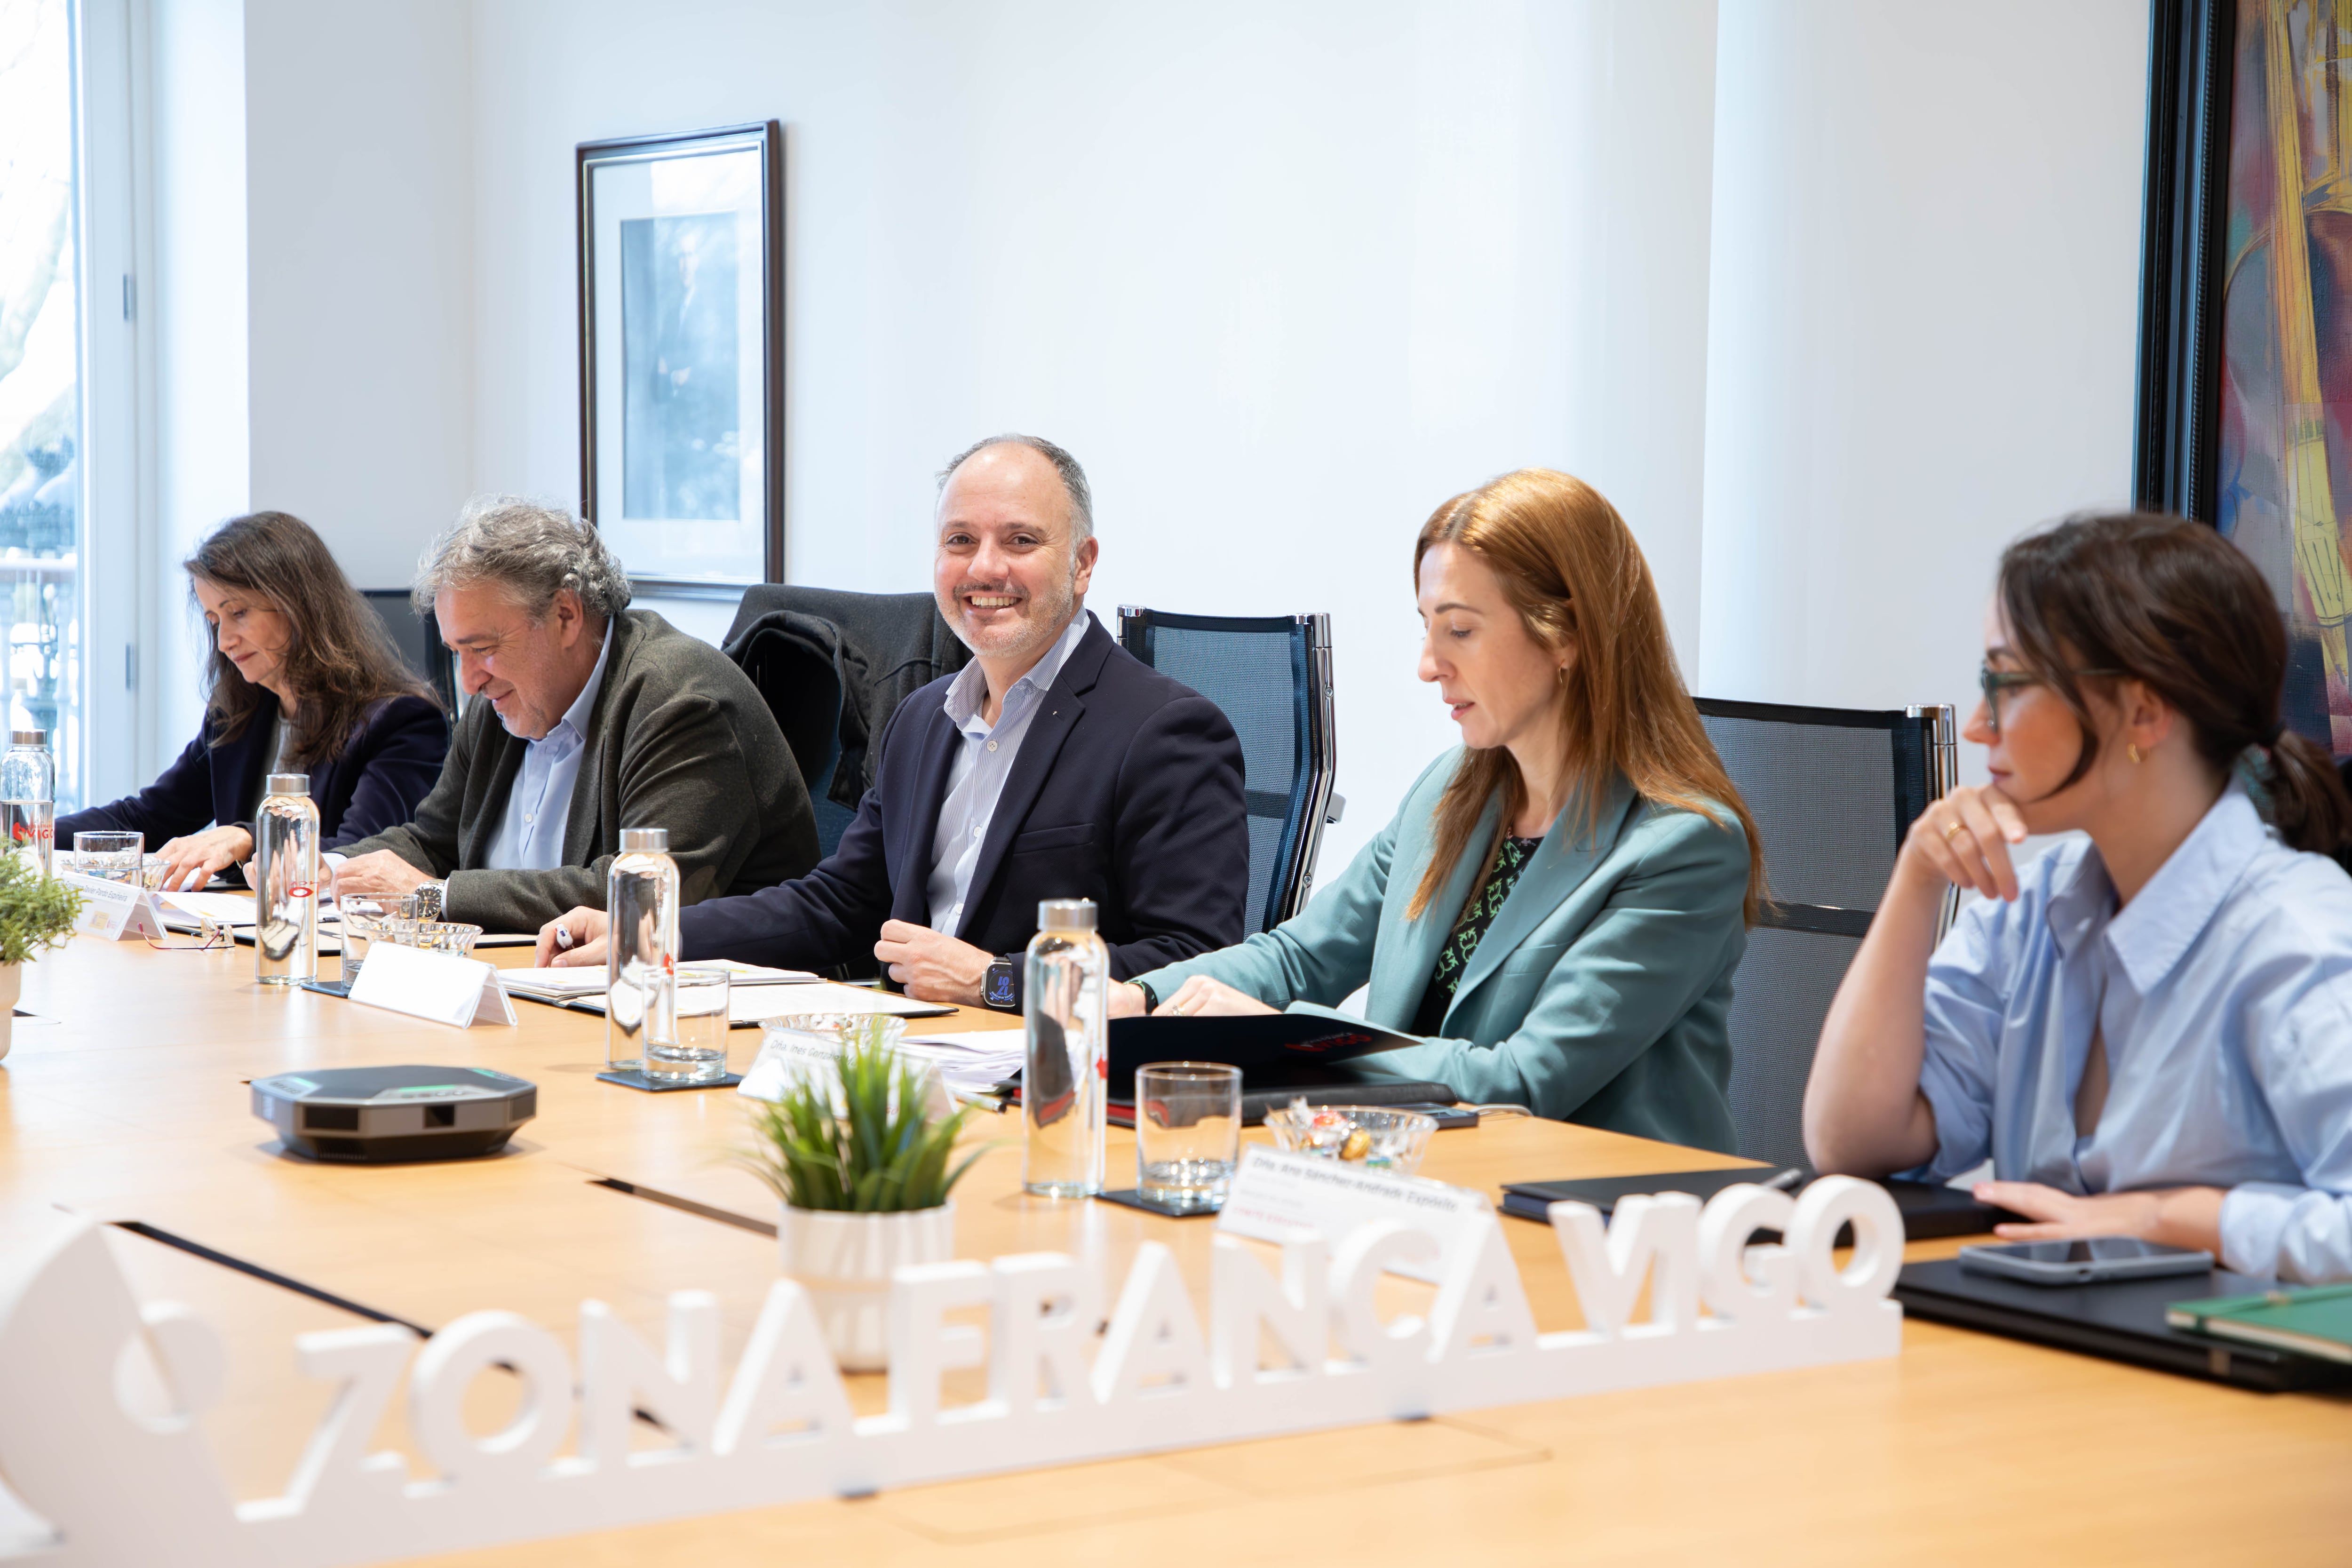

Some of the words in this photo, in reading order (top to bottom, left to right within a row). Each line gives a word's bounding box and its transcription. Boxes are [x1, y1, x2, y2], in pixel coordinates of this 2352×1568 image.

[95, 888, 109, 898] Pardo
[808, 1047, 842, 1061] Gonzále
[288, 1278, 857, 1512] ZONA
[886, 1219, 1539, 1436] FRANCA
[1548, 1174, 1905, 1341] VIGO
